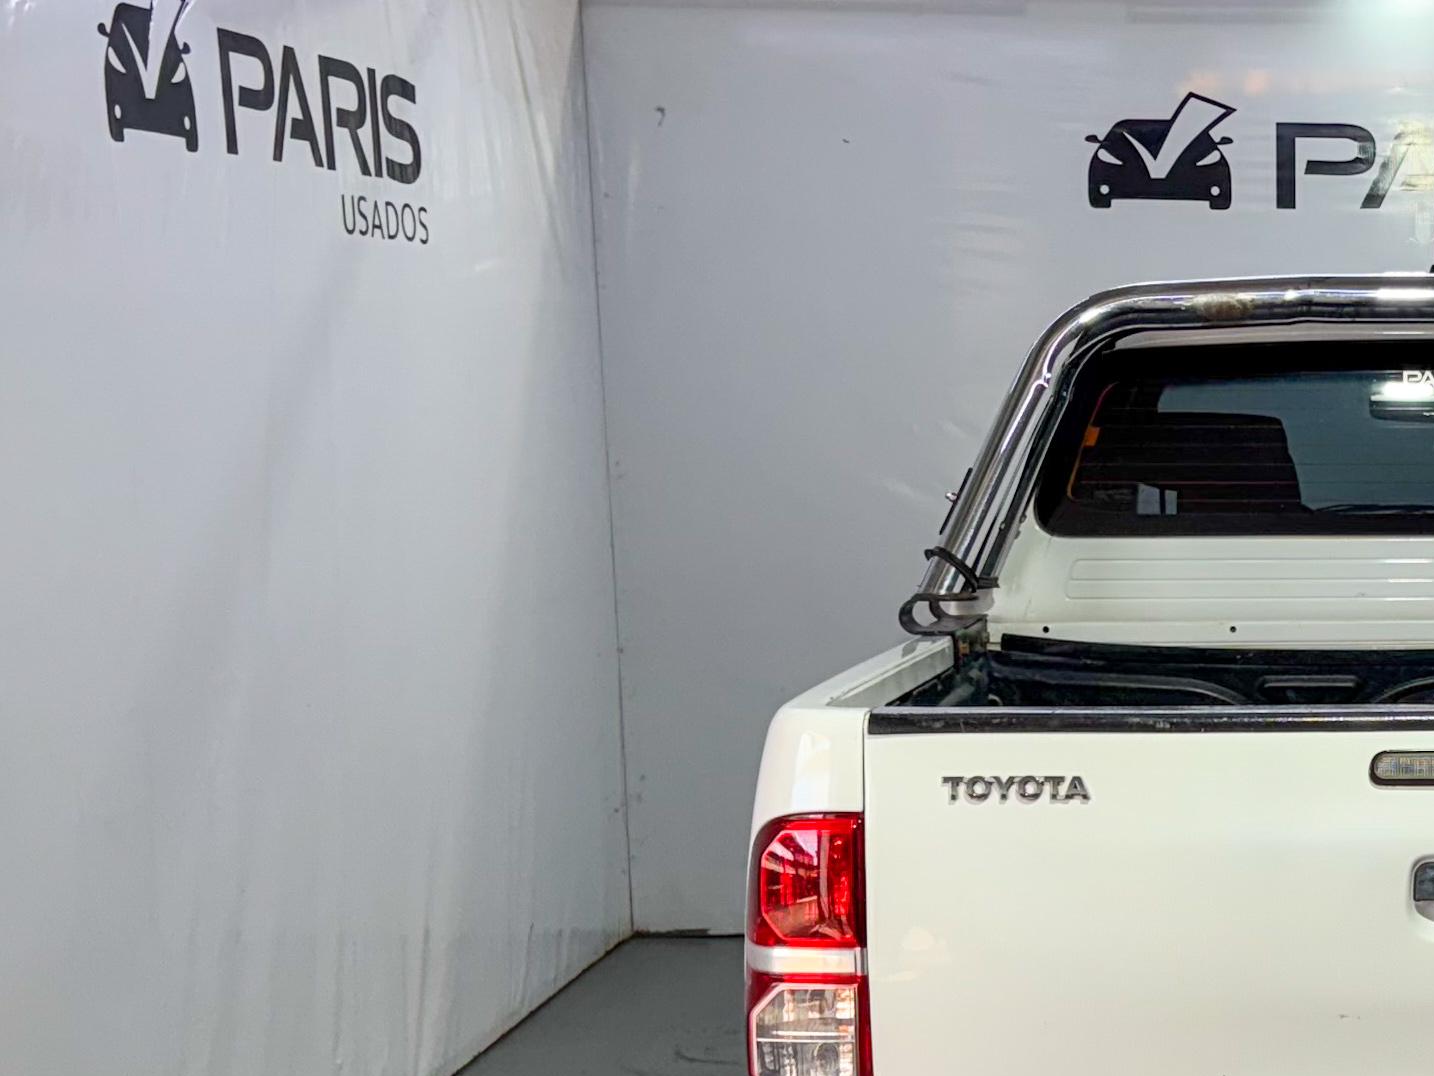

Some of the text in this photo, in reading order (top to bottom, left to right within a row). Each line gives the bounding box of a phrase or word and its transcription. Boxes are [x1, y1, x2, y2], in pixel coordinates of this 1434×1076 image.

[216, 27, 422, 184] PARIS
[341, 194, 429, 245] USADOS
[942, 775, 1091, 804] TOYOTA
